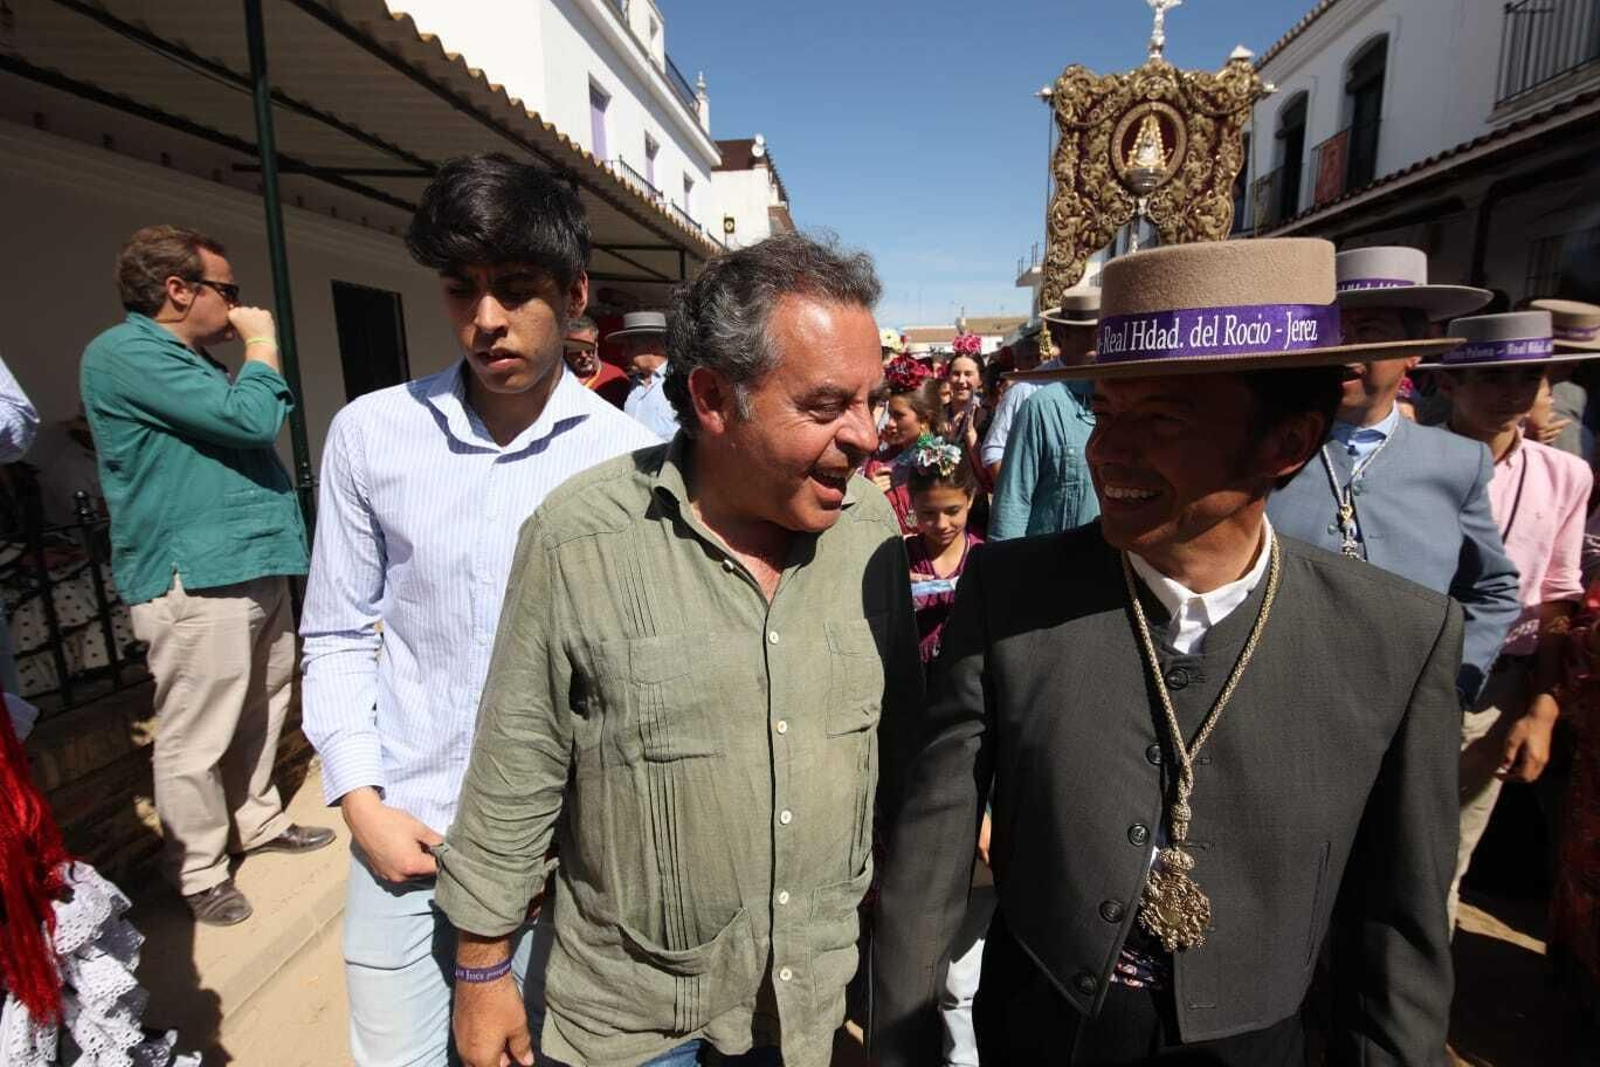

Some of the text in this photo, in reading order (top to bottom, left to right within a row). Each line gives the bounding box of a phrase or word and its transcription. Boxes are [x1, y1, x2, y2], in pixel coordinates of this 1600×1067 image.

[1103, 322, 1128, 355] Real
[1130, 317, 1184, 351] Hdad.
[1189, 316, 1219, 348] del
[1222, 313, 1271, 346] Rocio
[1284, 310, 1318, 350] Jerez
